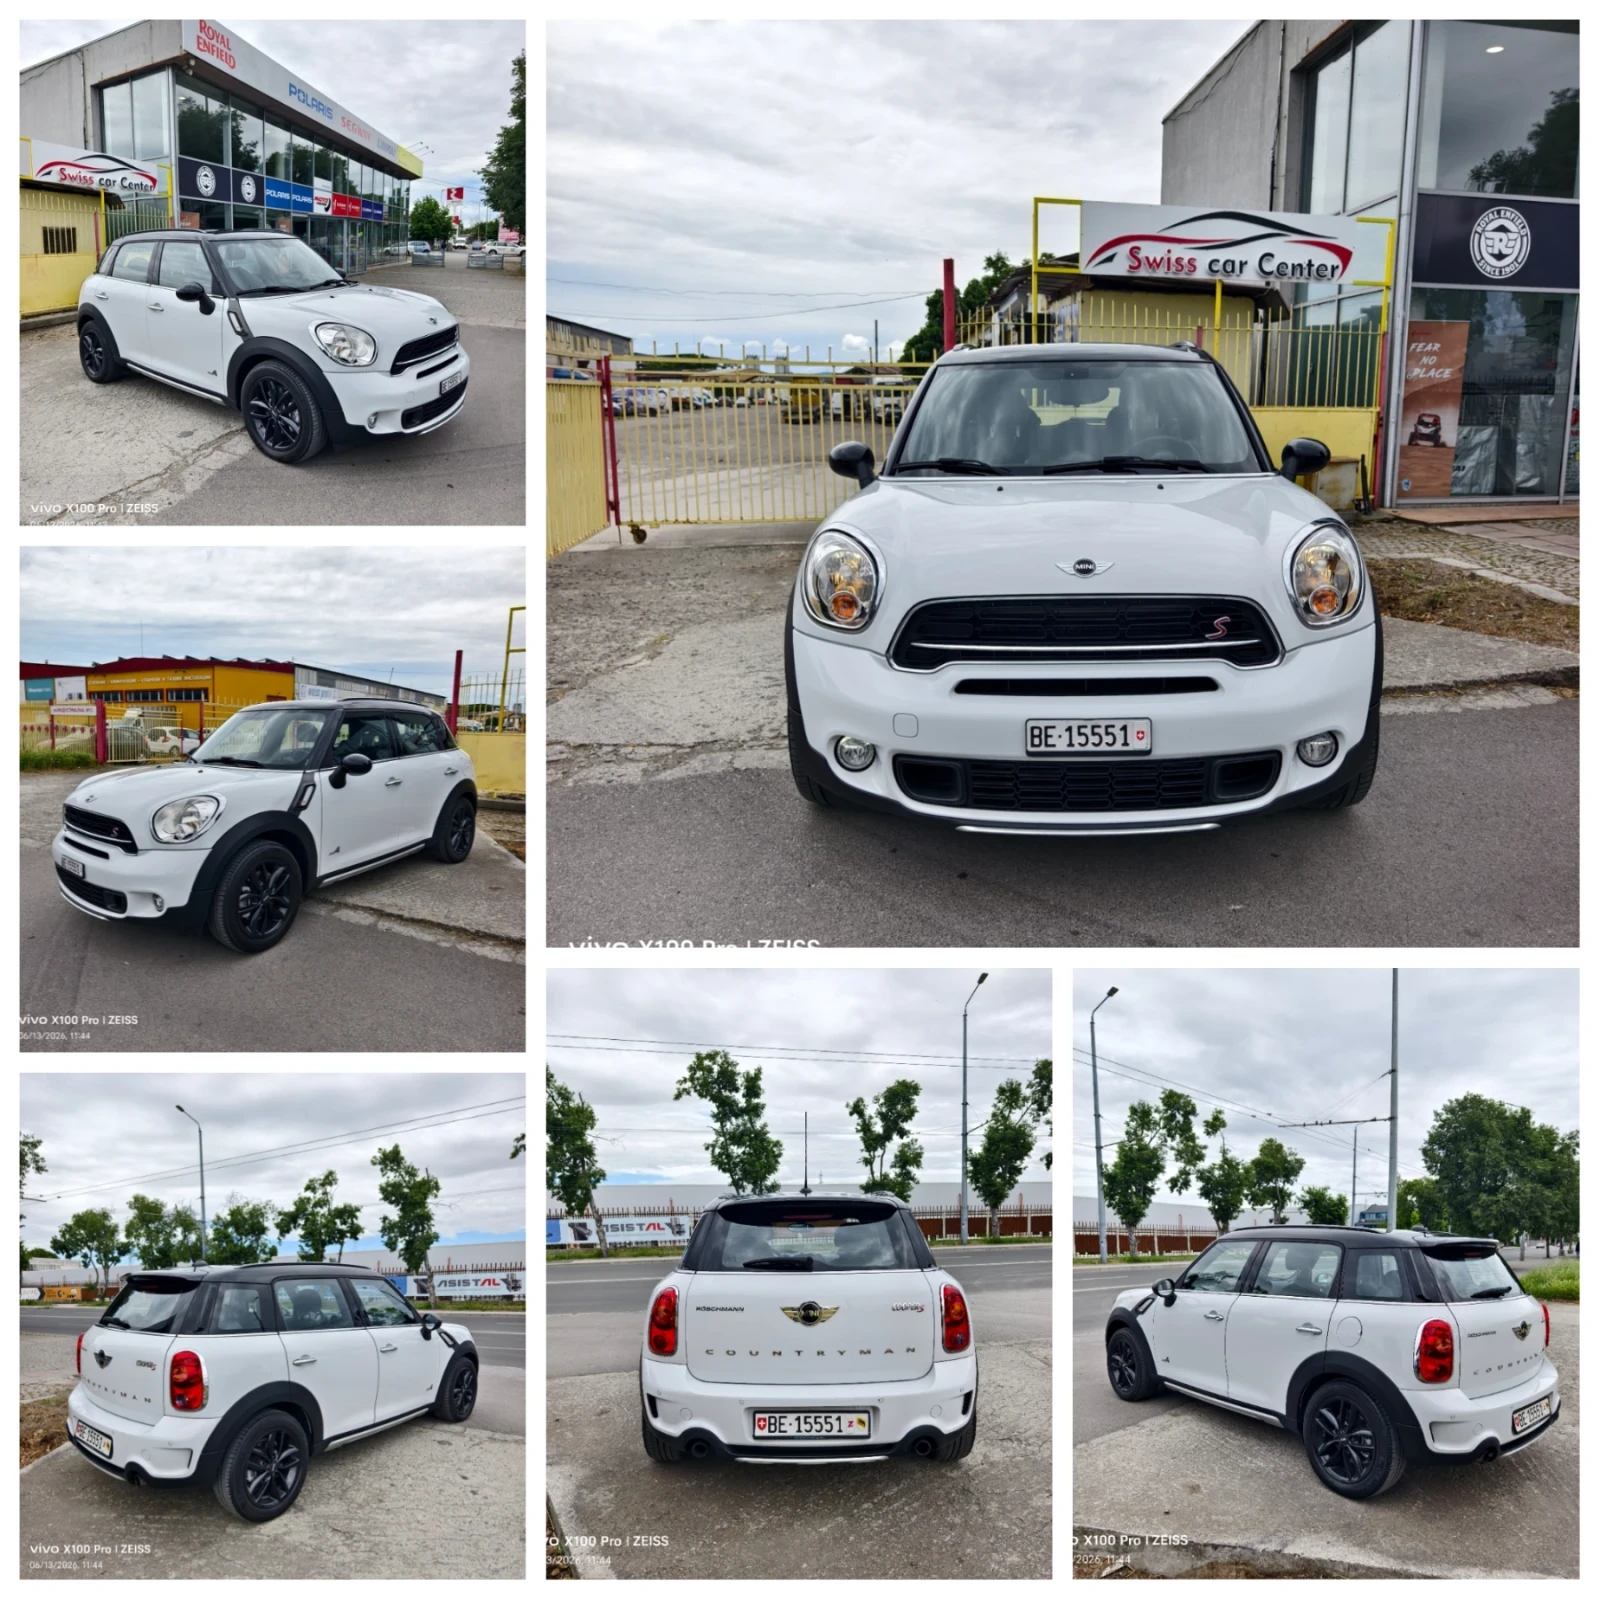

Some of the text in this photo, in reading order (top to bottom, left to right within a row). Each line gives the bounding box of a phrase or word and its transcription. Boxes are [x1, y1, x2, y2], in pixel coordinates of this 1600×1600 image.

[199, 20, 232, 51] ROYAL
[196, 35, 237, 70] ENFIELD
[288, 82, 334, 120] POLARIS
[59, 167, 154, 192] Swiss car Center
[266, 188, 291, 200] POLARIS
[1476, 209, 1528, 236] ROYAL ENFIELD
[1127, 246, 1340, 281] Swiss car Center
[1478, 259, 1520, 276] SINCE 1901
[1409, 342, 1442, 352] FEAR
[1420, 355, 1438, 365] NO
[1410, 367, 1454, 379] PLACE
[1205, 616, 1231, 640] S
[437, 1278, 501, 1288] ASISTAL
[705, 1347, 916, 1357] COUNTRYMAN
